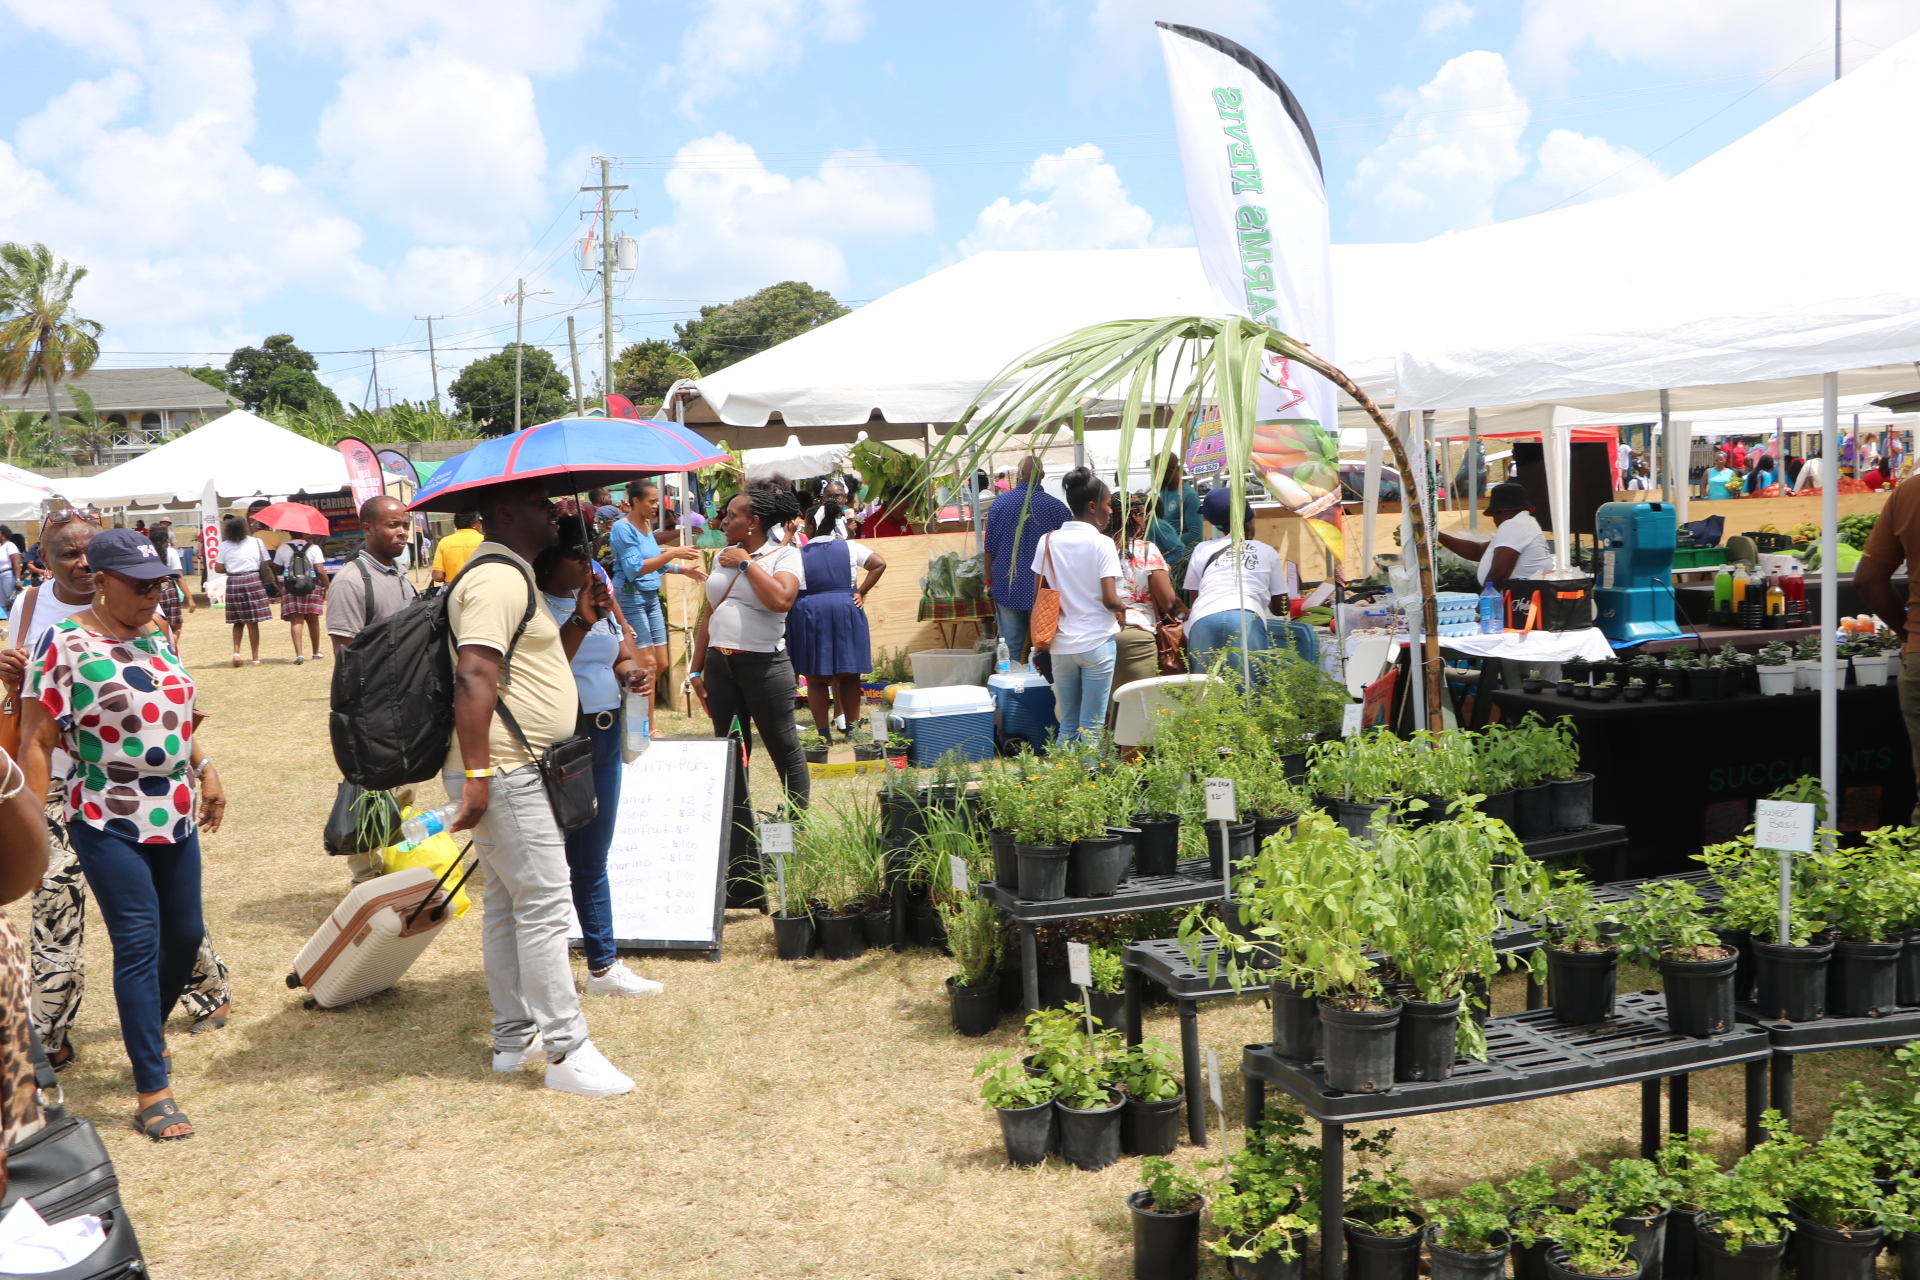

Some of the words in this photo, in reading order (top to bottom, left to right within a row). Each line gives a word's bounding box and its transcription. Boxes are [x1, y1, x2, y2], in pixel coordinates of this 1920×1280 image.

[1708, 746, 1892, 791] SUCCULNTS
[619, 794, 653, 804] onut
[617, 810, 648, 822] rsop
[1758, 803, 1799, 818] Sweet
[611, 892, 646, 905] colate
